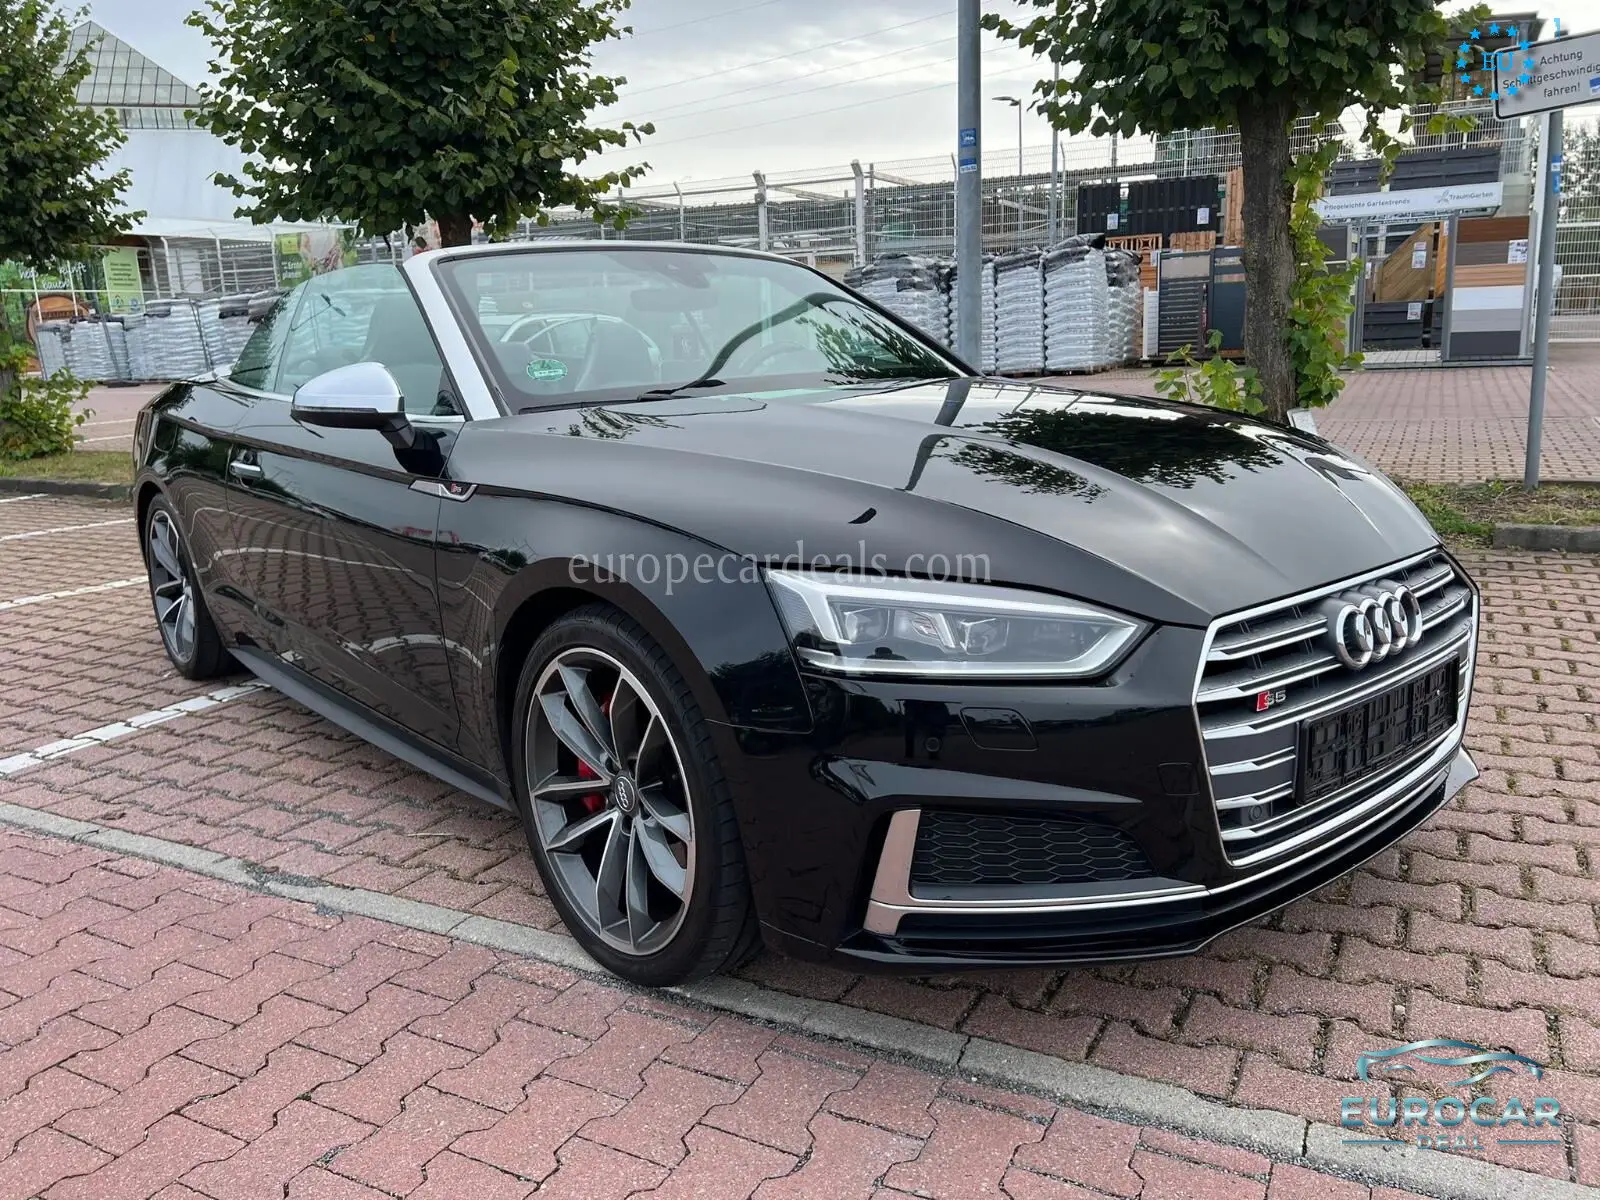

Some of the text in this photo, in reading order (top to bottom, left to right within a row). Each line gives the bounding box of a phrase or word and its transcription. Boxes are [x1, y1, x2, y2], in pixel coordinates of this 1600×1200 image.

[1540, 51, 1583, 66] Achtung
[1503, 63, 1600, 89] Schttgeschwindig
[1543, 82, 1580, 98] fahren!
[1260, 690, 1287, 708] S5
